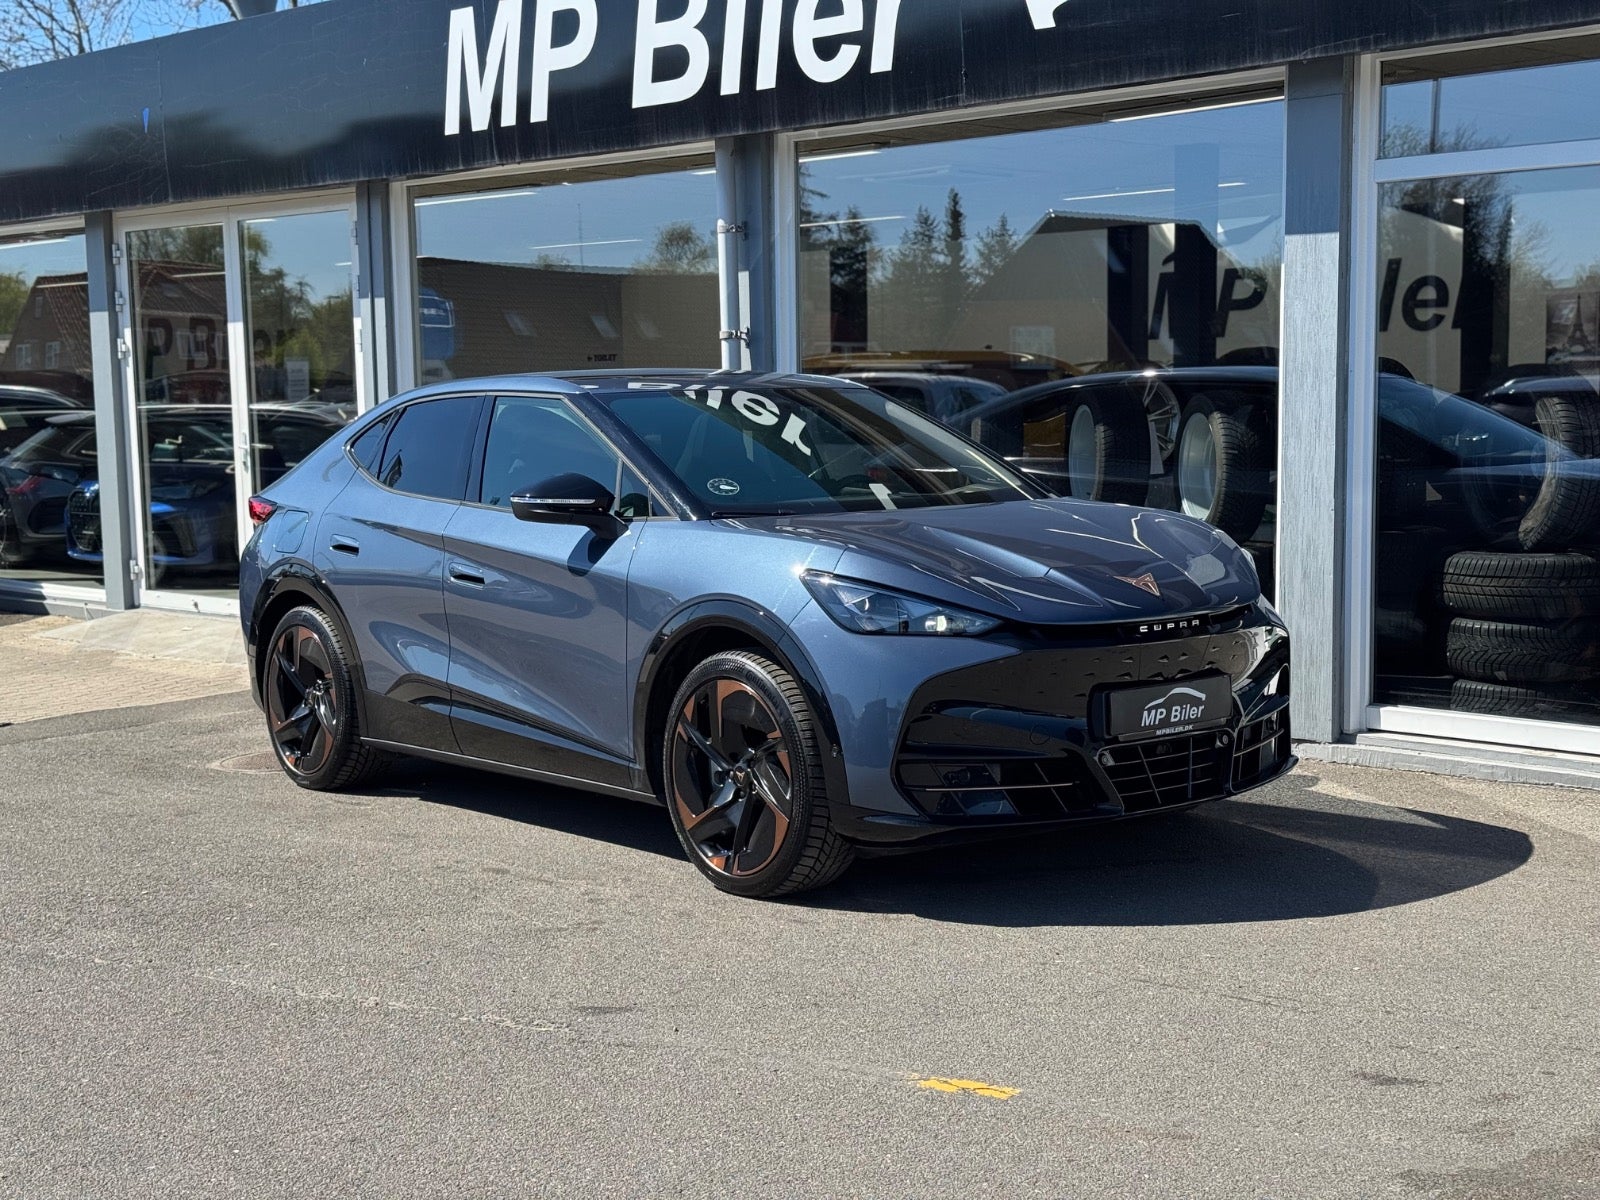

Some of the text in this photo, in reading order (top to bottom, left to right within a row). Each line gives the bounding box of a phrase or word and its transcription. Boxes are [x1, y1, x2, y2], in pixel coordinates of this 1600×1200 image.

[444, 0, 598, 136] MP
[1139, 619, 1200, 633] CUPRA
[1141, 703, 1205, 727] MP Biler
